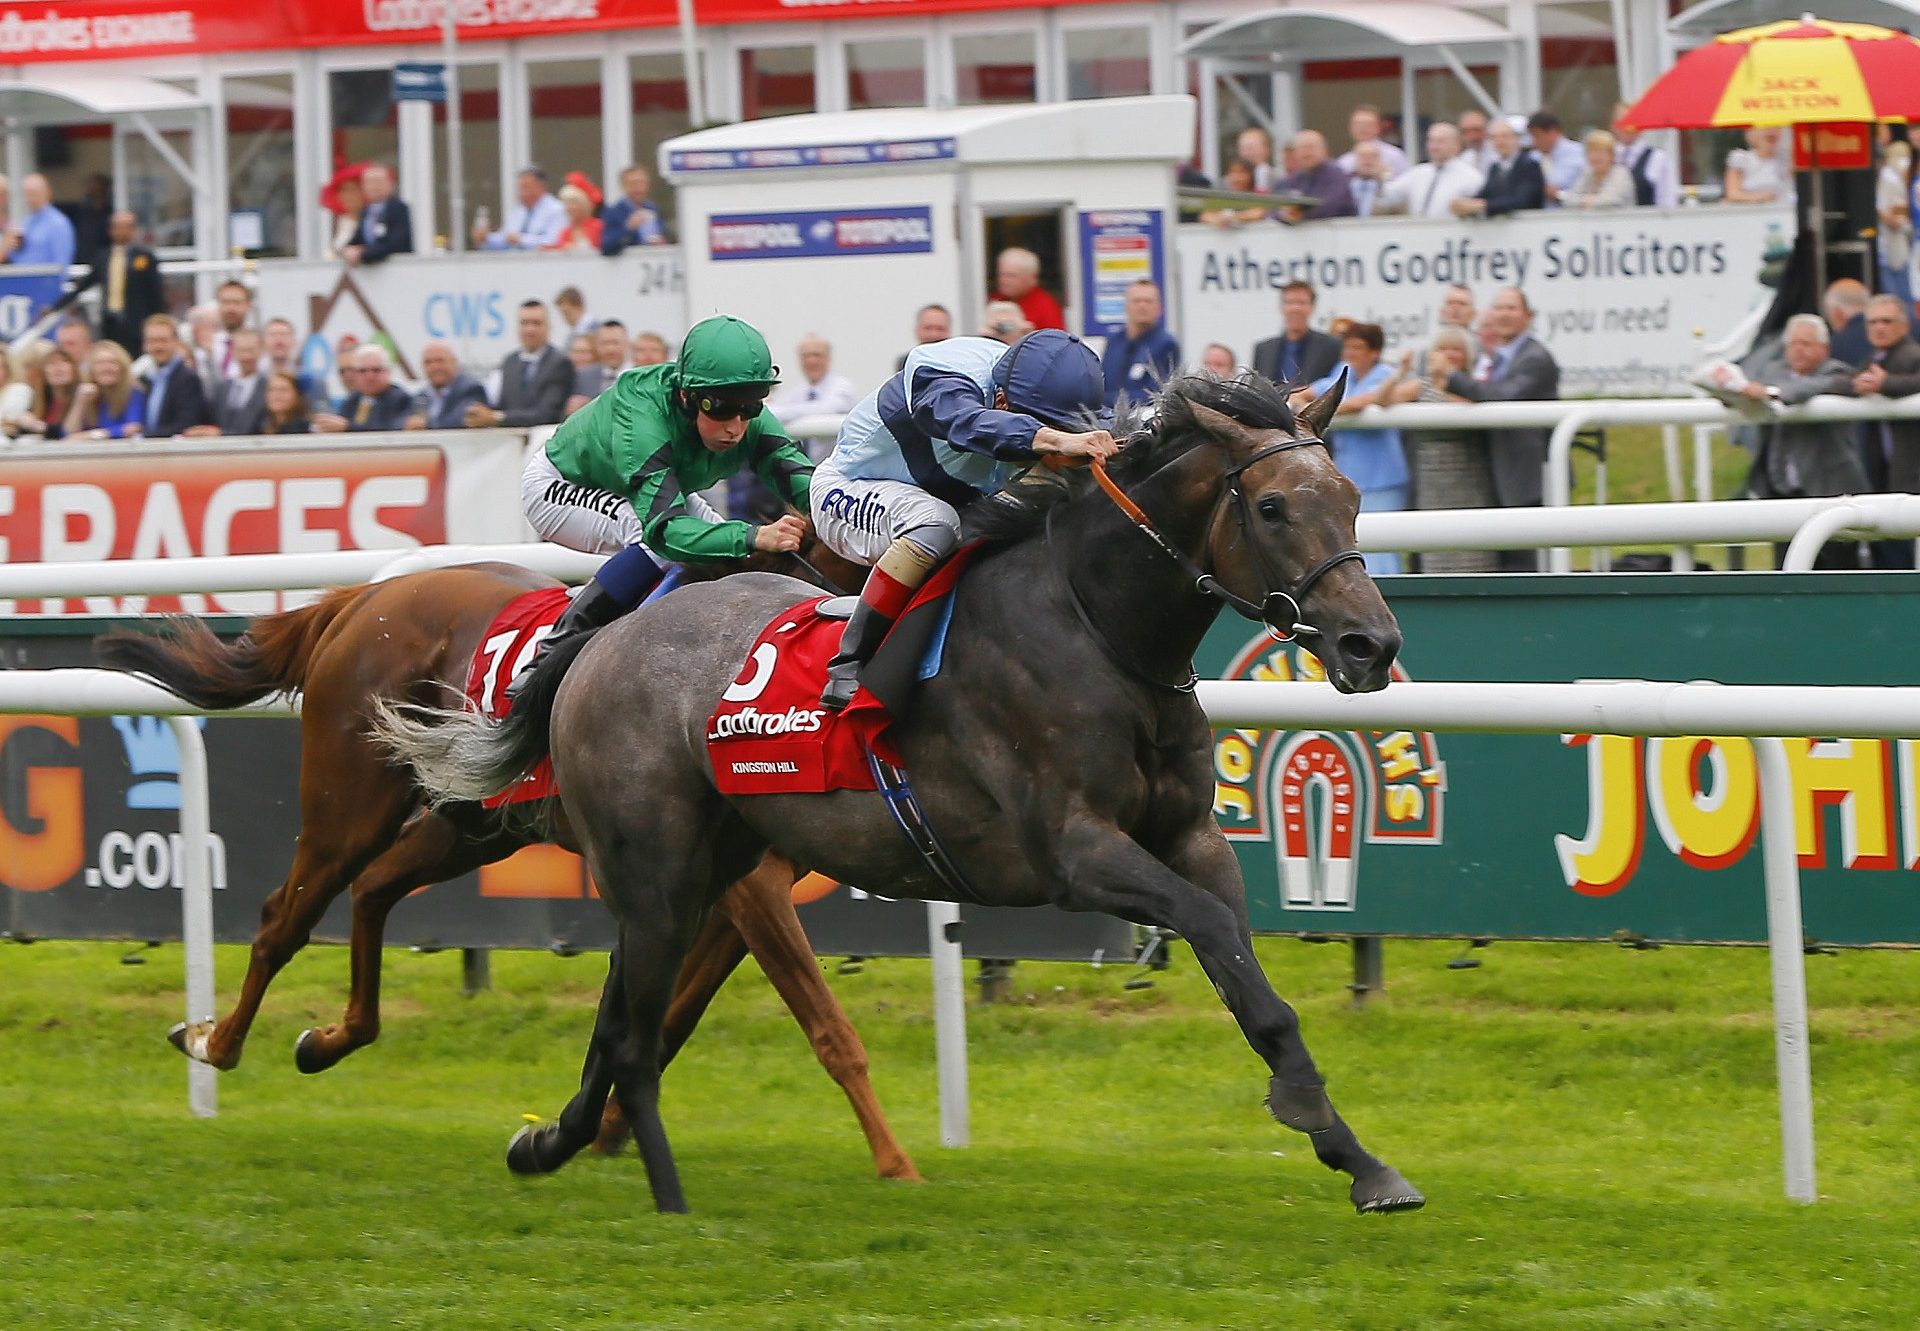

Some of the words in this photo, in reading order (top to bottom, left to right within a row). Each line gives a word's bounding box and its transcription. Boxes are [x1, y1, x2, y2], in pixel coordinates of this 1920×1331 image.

[1200, 247, 1365, 291] Atherton
[1378, 238, 1531, 288] Godfrey
[1543, 231, 1728, 279] Solicitors
[423, 291, 505, 338] CWS
[1604, 297, 1671, 331] need
[40, 475, 430, 614] RACES
[731, 761, 777, 774] KINGSTON
[777, 761, 799, 773] HILL
